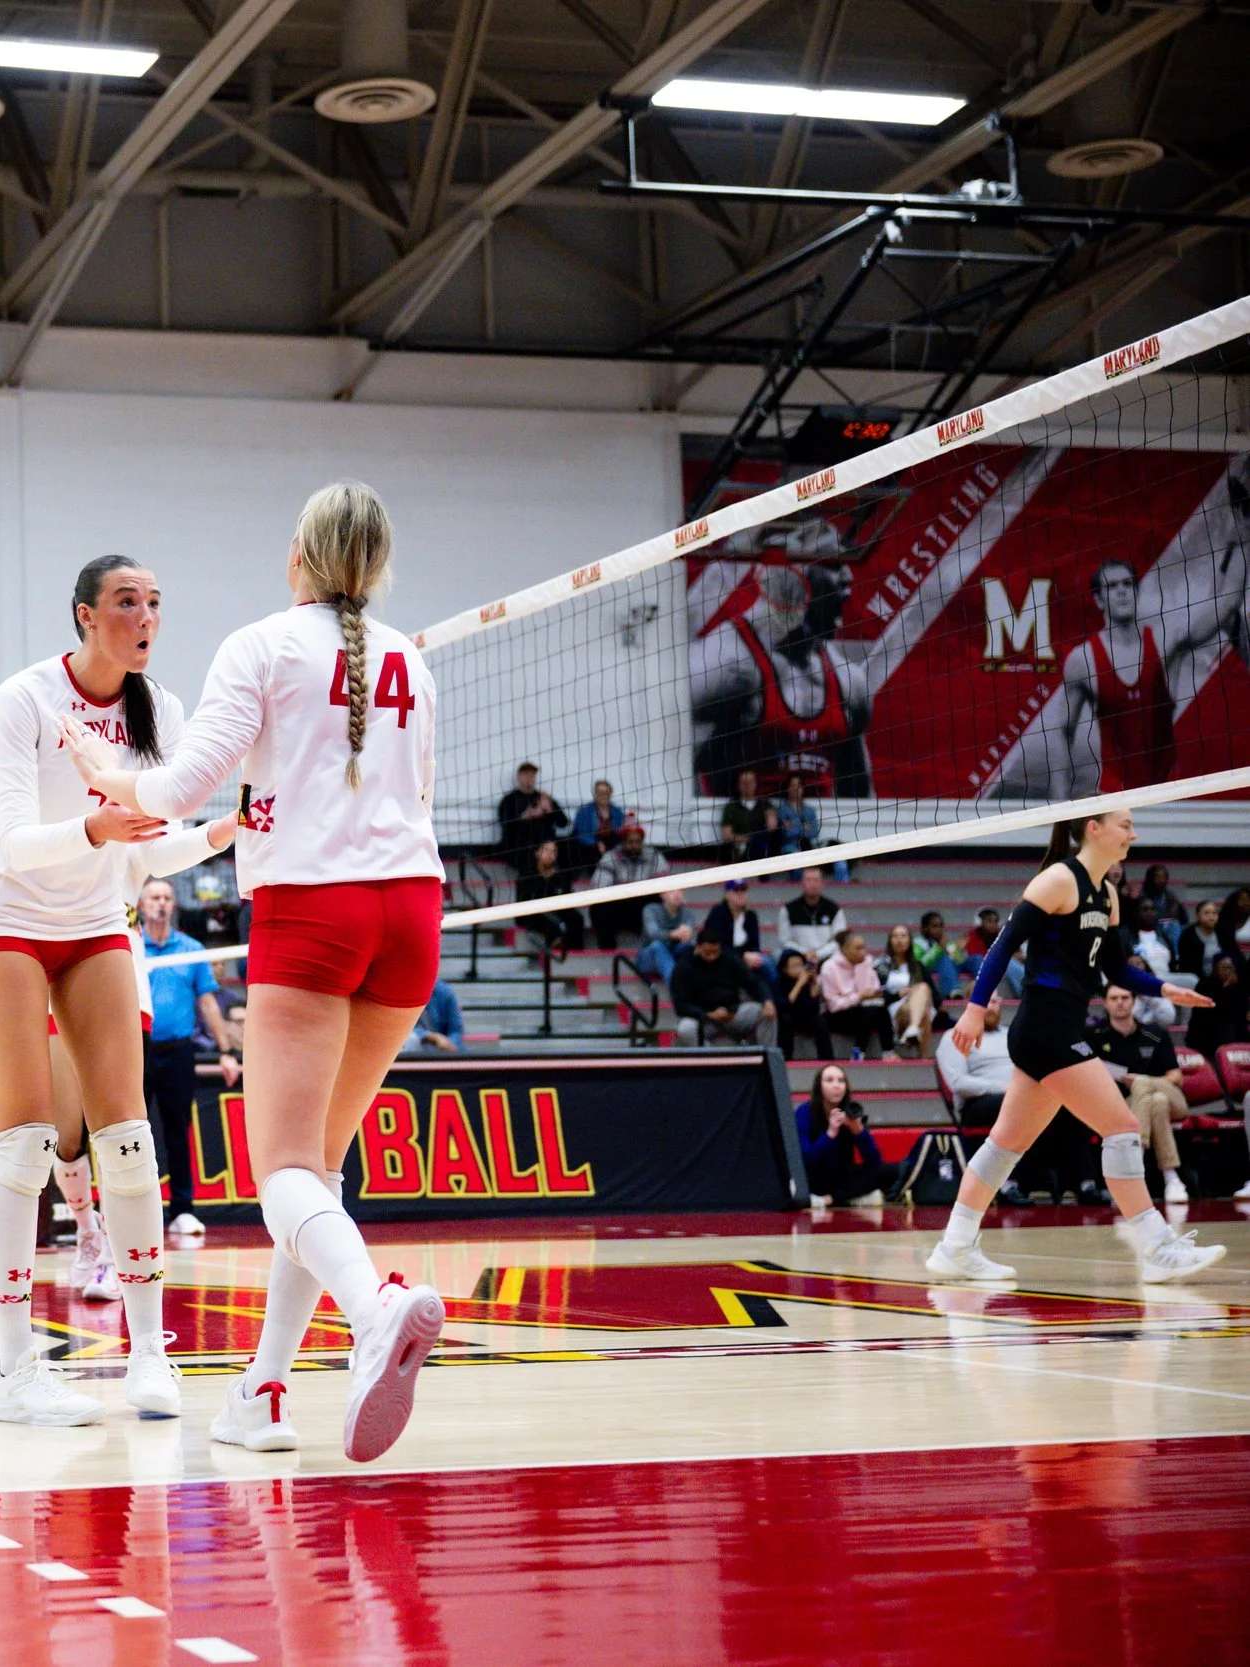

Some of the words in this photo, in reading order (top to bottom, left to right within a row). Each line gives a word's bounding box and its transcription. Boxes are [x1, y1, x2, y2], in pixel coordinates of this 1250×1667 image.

[1103, 335, 1161, 375] MARYLAND
[937, 408, 985, 442] MARYLAND
[795, 468, 837, 498] MARYLAND
[865, 462, 1001, 623] WRESTLING
[981, 577, 1057, 651] M
